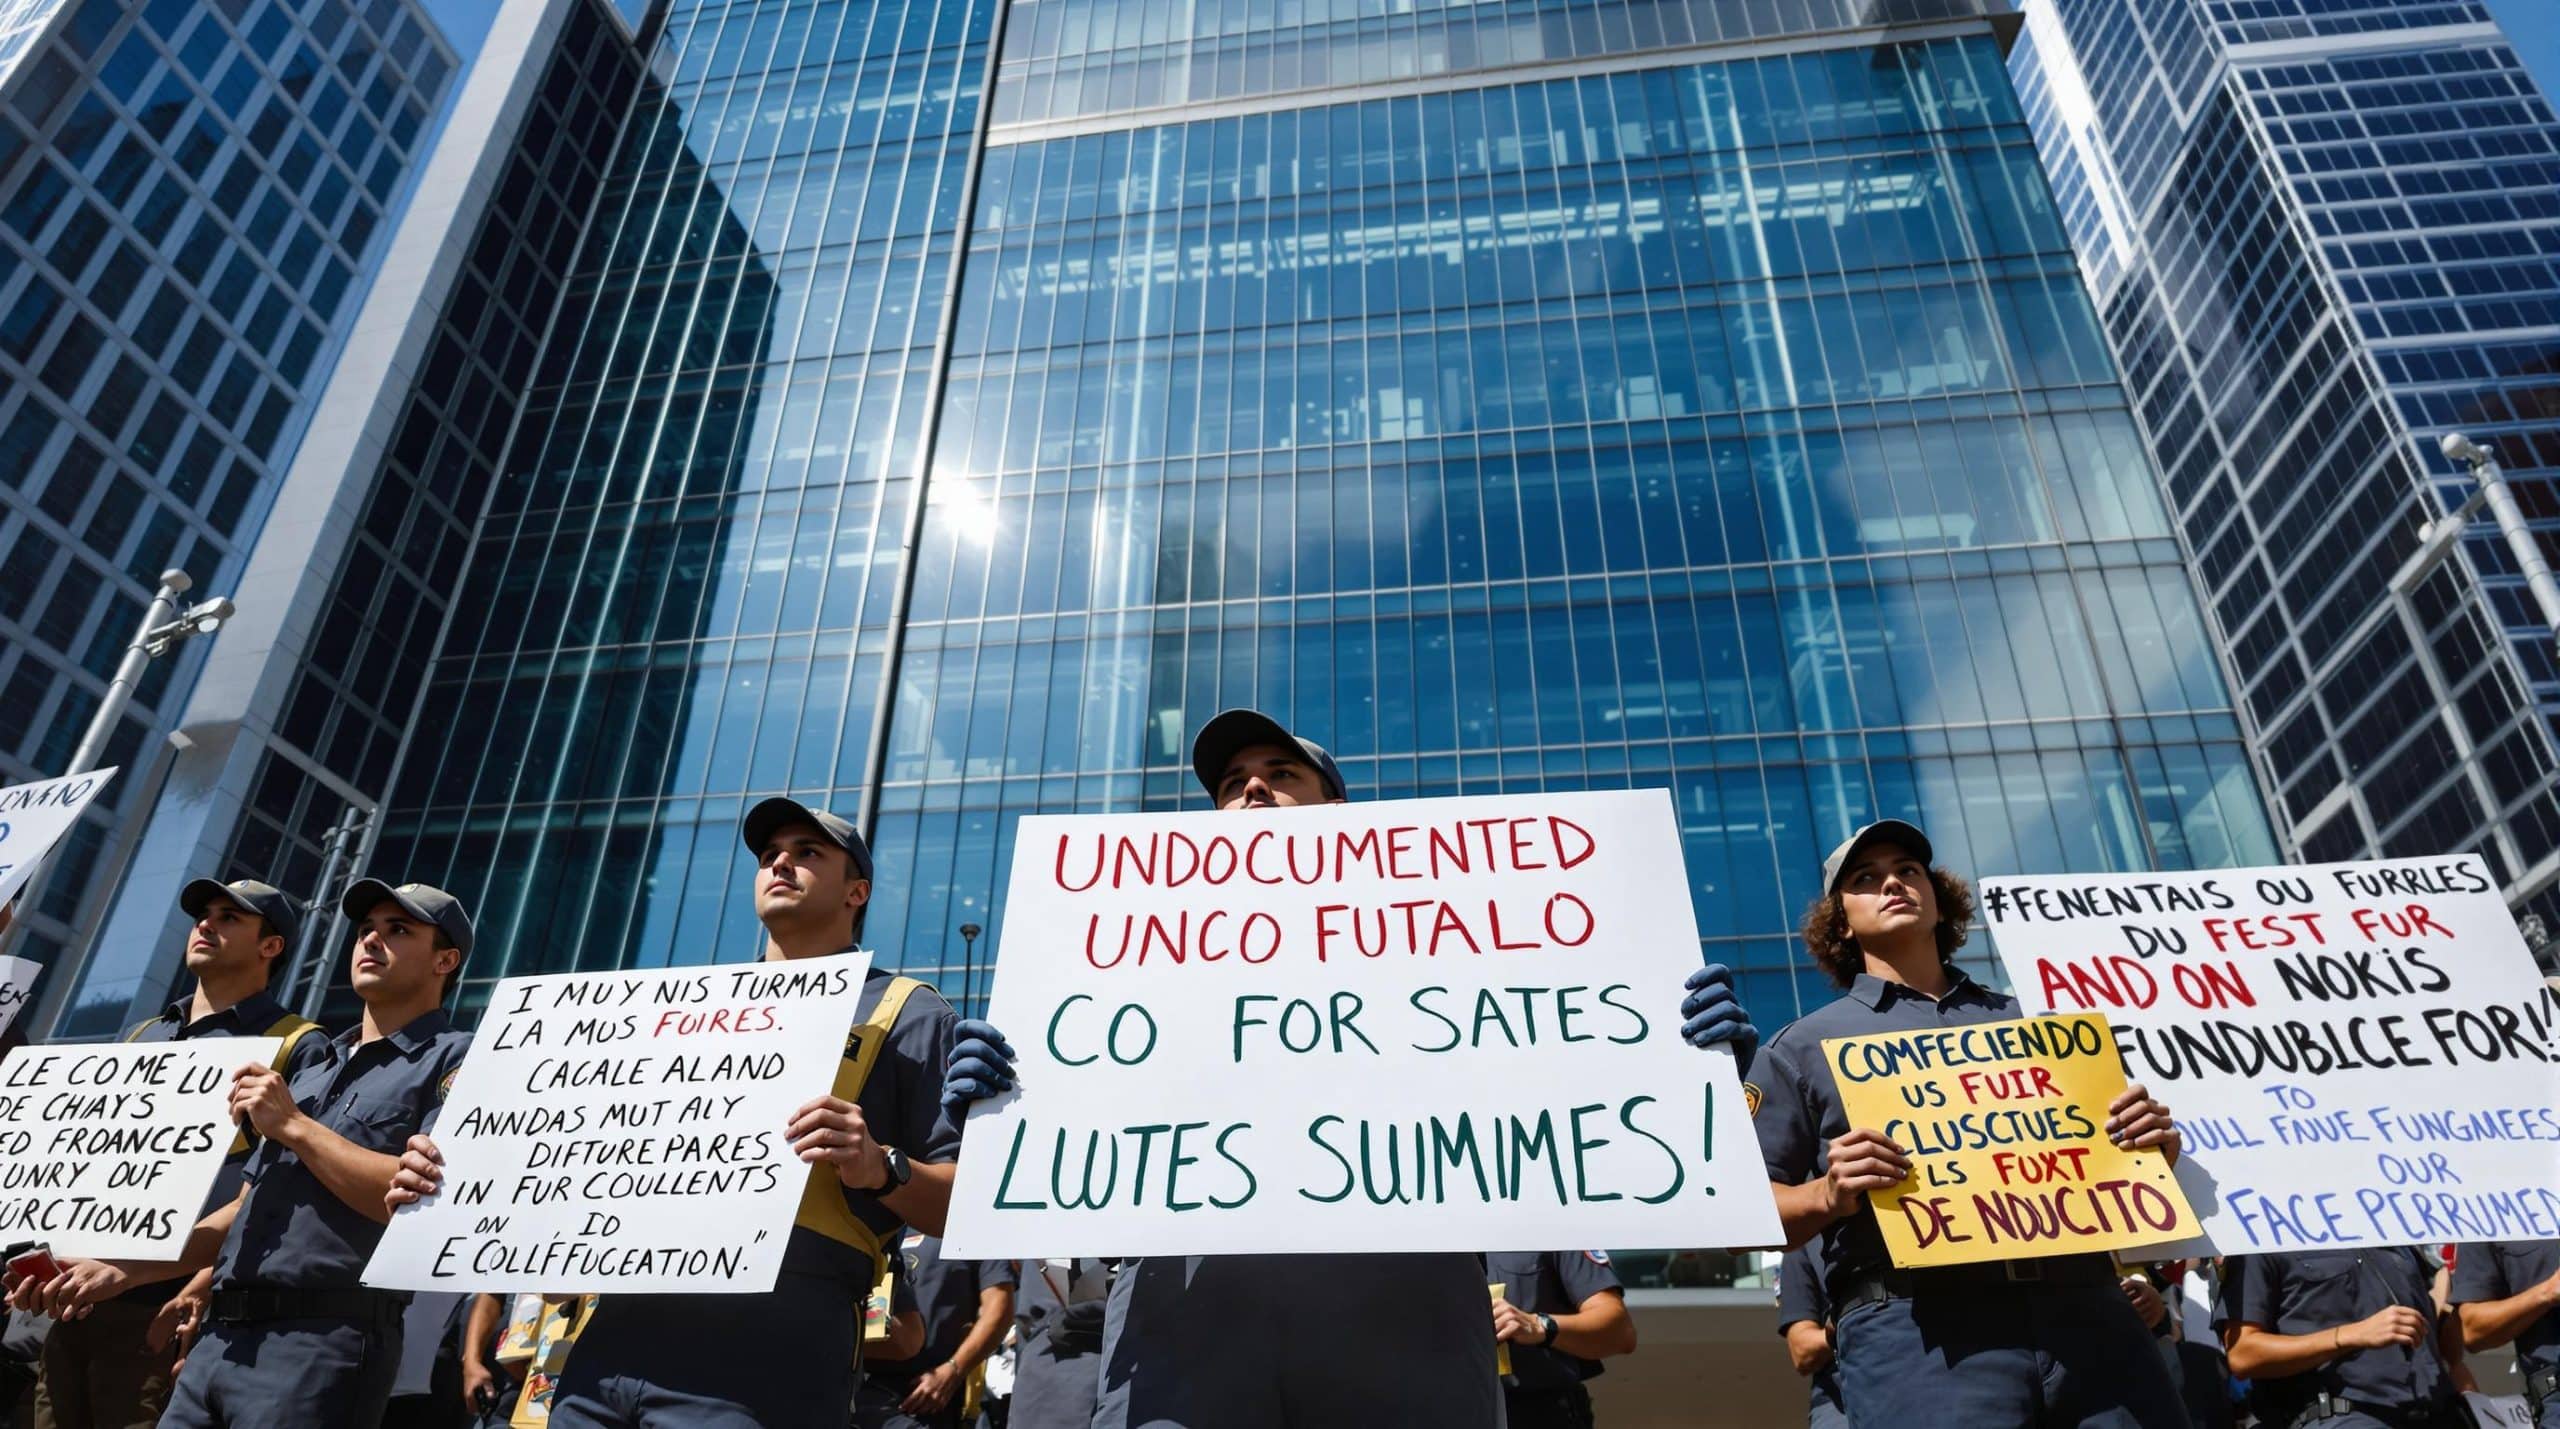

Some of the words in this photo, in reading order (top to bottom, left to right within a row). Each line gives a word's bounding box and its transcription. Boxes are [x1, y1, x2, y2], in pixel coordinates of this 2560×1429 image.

[1055, 815, 1595, 892] UNDOCUMENTED
[2256, 877, 2314, 906] OU
[2332, 862, 2490, 899] FURRLES
[1085, 909, 1282, 969] UNCO
[1315, 892, 1595, 963] FUTALO
[2121, 925, 2188, 959] DU
[2203, 912, 2328, 953] FEST
[2351, 904, 2455, 941] FUR
[509, 985, 543, 1014] I
[554, 979, 645, 1008] MUY
[654, 975, 711, 1003] NIS
[731, 968, 849, 999] TURMAS
[2037, 955, 2159, 1010] AND
[2173, 961, 2257, 1009] ON
[493, 1019, 542, 1051] LA
[565, 1015, 638, 1046] MUS
[1046, 993, 1157, 1066] CO
[1232, 990, 1380, 1063] FOR
[1409, 983, 1649, 1052] SATES
[6, 1056, 61, 1087] LE
[1838, 1019, 2101, 1082] COMFECIENDO
[526, 1058, 653, 1094] CACALE
[1900, 1081, 1946, 1108] US
[1958, 1067, 2064, 1105] FUIR
[454, 1105, 586, 1138] ANNDAS
[600, 1100, 672, 1130] MUT
[2263, 1085, 2317, 1111] TO
[48, 1122, 216, 1154] FROANCES
[664, 1131, 774, 1164] PARES
[0, 1160, 91, 1189] UNRY
[454, 1179, 493, 1206] IN
[512, 1174, 572, 1204] FUR
[583, 1163, 782, 1200] COULLENTS
[1992, 1147, 2092, 1186] FUXT
[2377, 1151, 2462, 1185] OUR
[1897, 1196, 1972, 1250] DE
[2225, 1188, 2359, 1247] FACE
